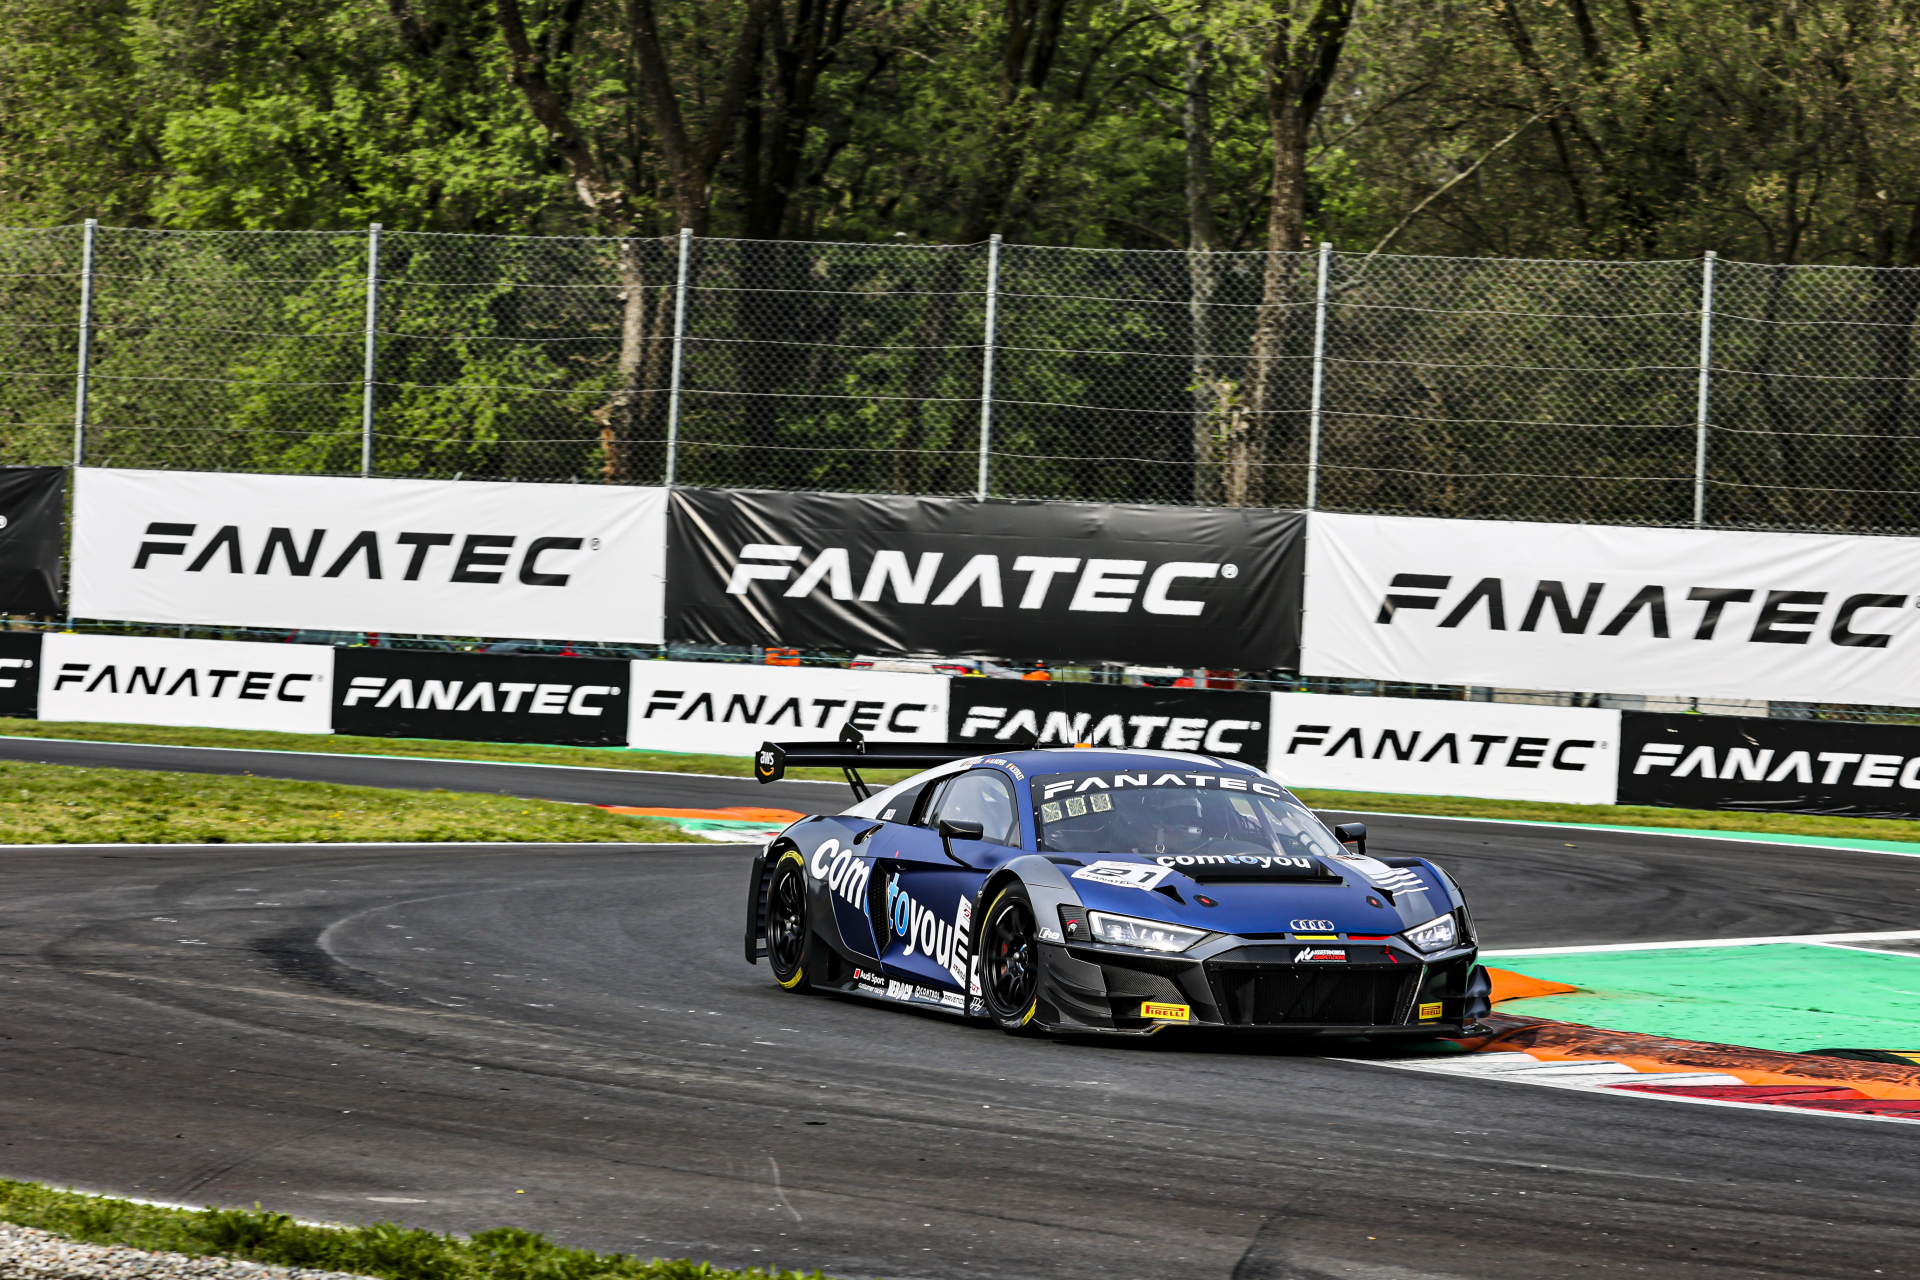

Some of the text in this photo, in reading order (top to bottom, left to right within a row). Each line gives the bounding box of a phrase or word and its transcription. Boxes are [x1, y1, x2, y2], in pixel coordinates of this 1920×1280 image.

[760, 750, 775, 765] aws
[1043, 773, 1281, 800] FANATEC
[1156, 853, 1312, 869] comtoyou
[860, 970, 885, 985] Audi Sport
[1145, 1005, 1184, 1018] PIRELLI
[1421, 1005, 1441, 1016] PIRELLI
